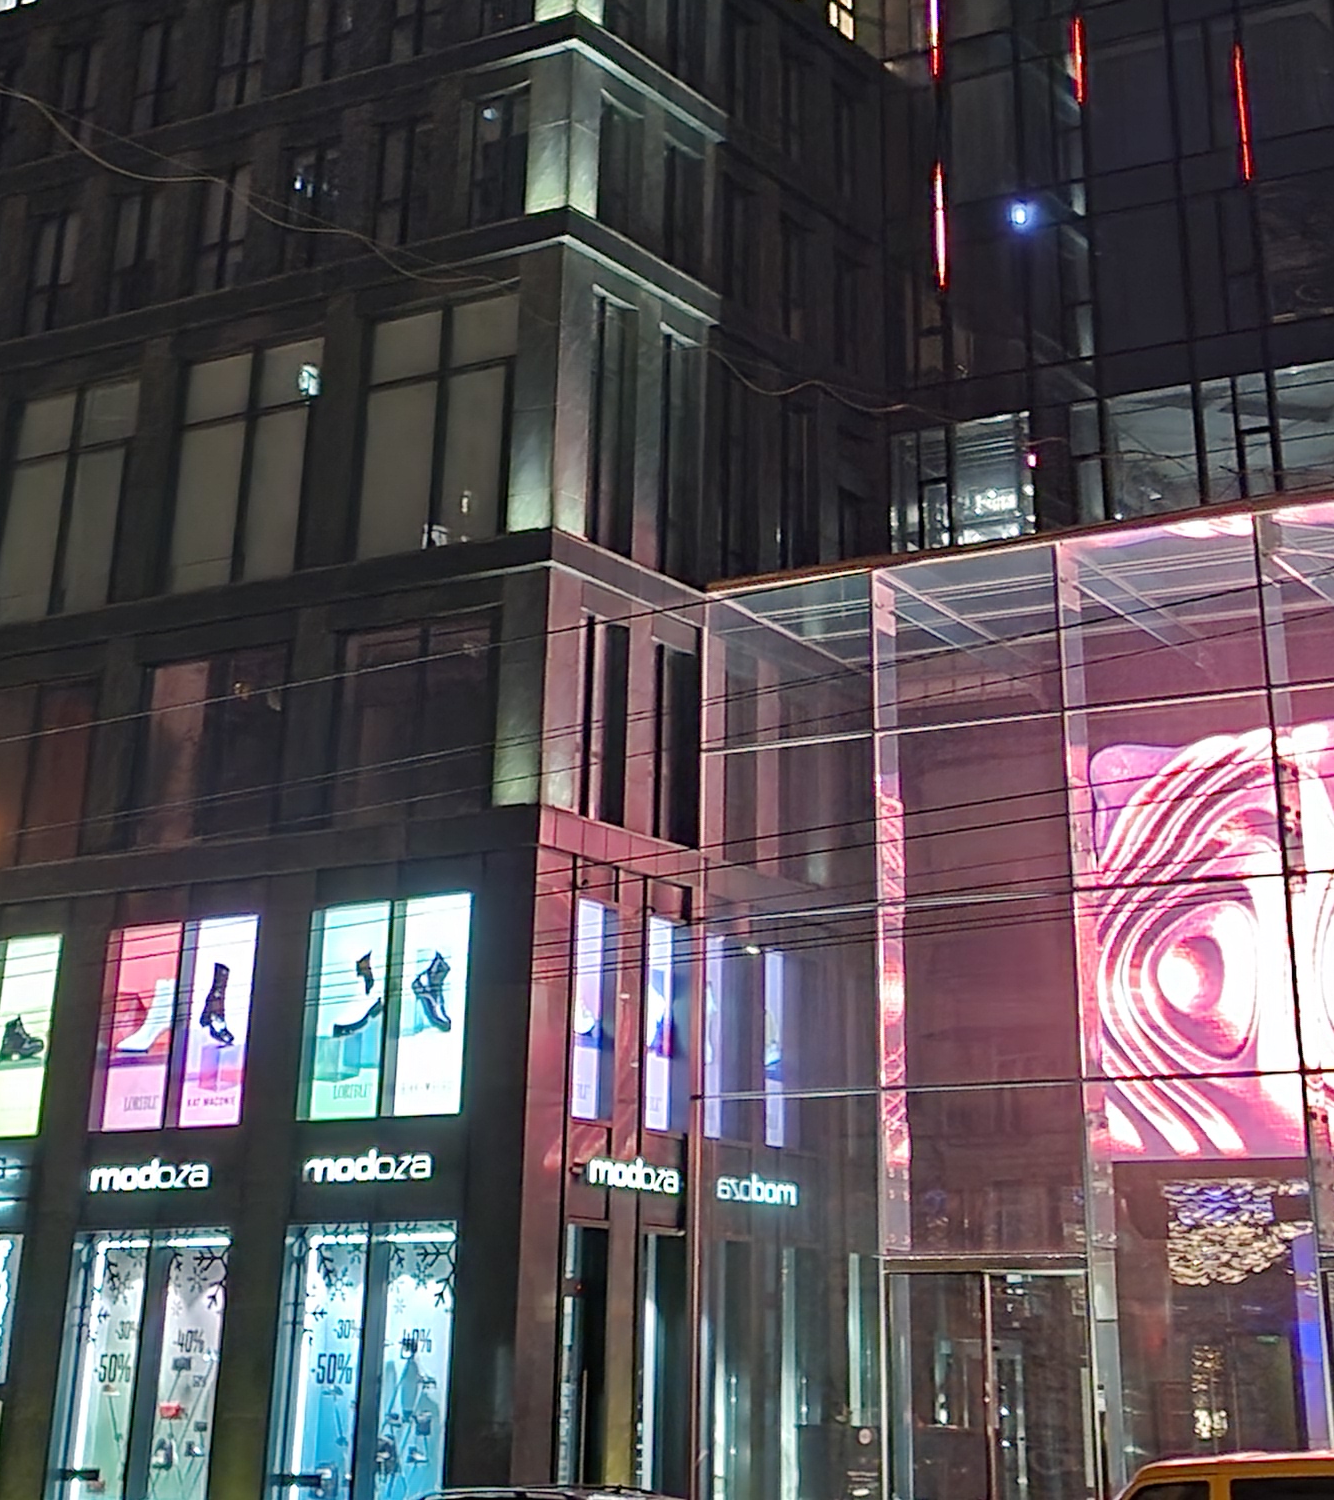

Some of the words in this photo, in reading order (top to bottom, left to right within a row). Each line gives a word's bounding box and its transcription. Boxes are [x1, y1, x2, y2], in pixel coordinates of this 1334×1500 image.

[89, 1157, 210, 1192] modoza
[302, 1147, 432, 1183] modoza
[589, 1157, 680, 1194] modoza
